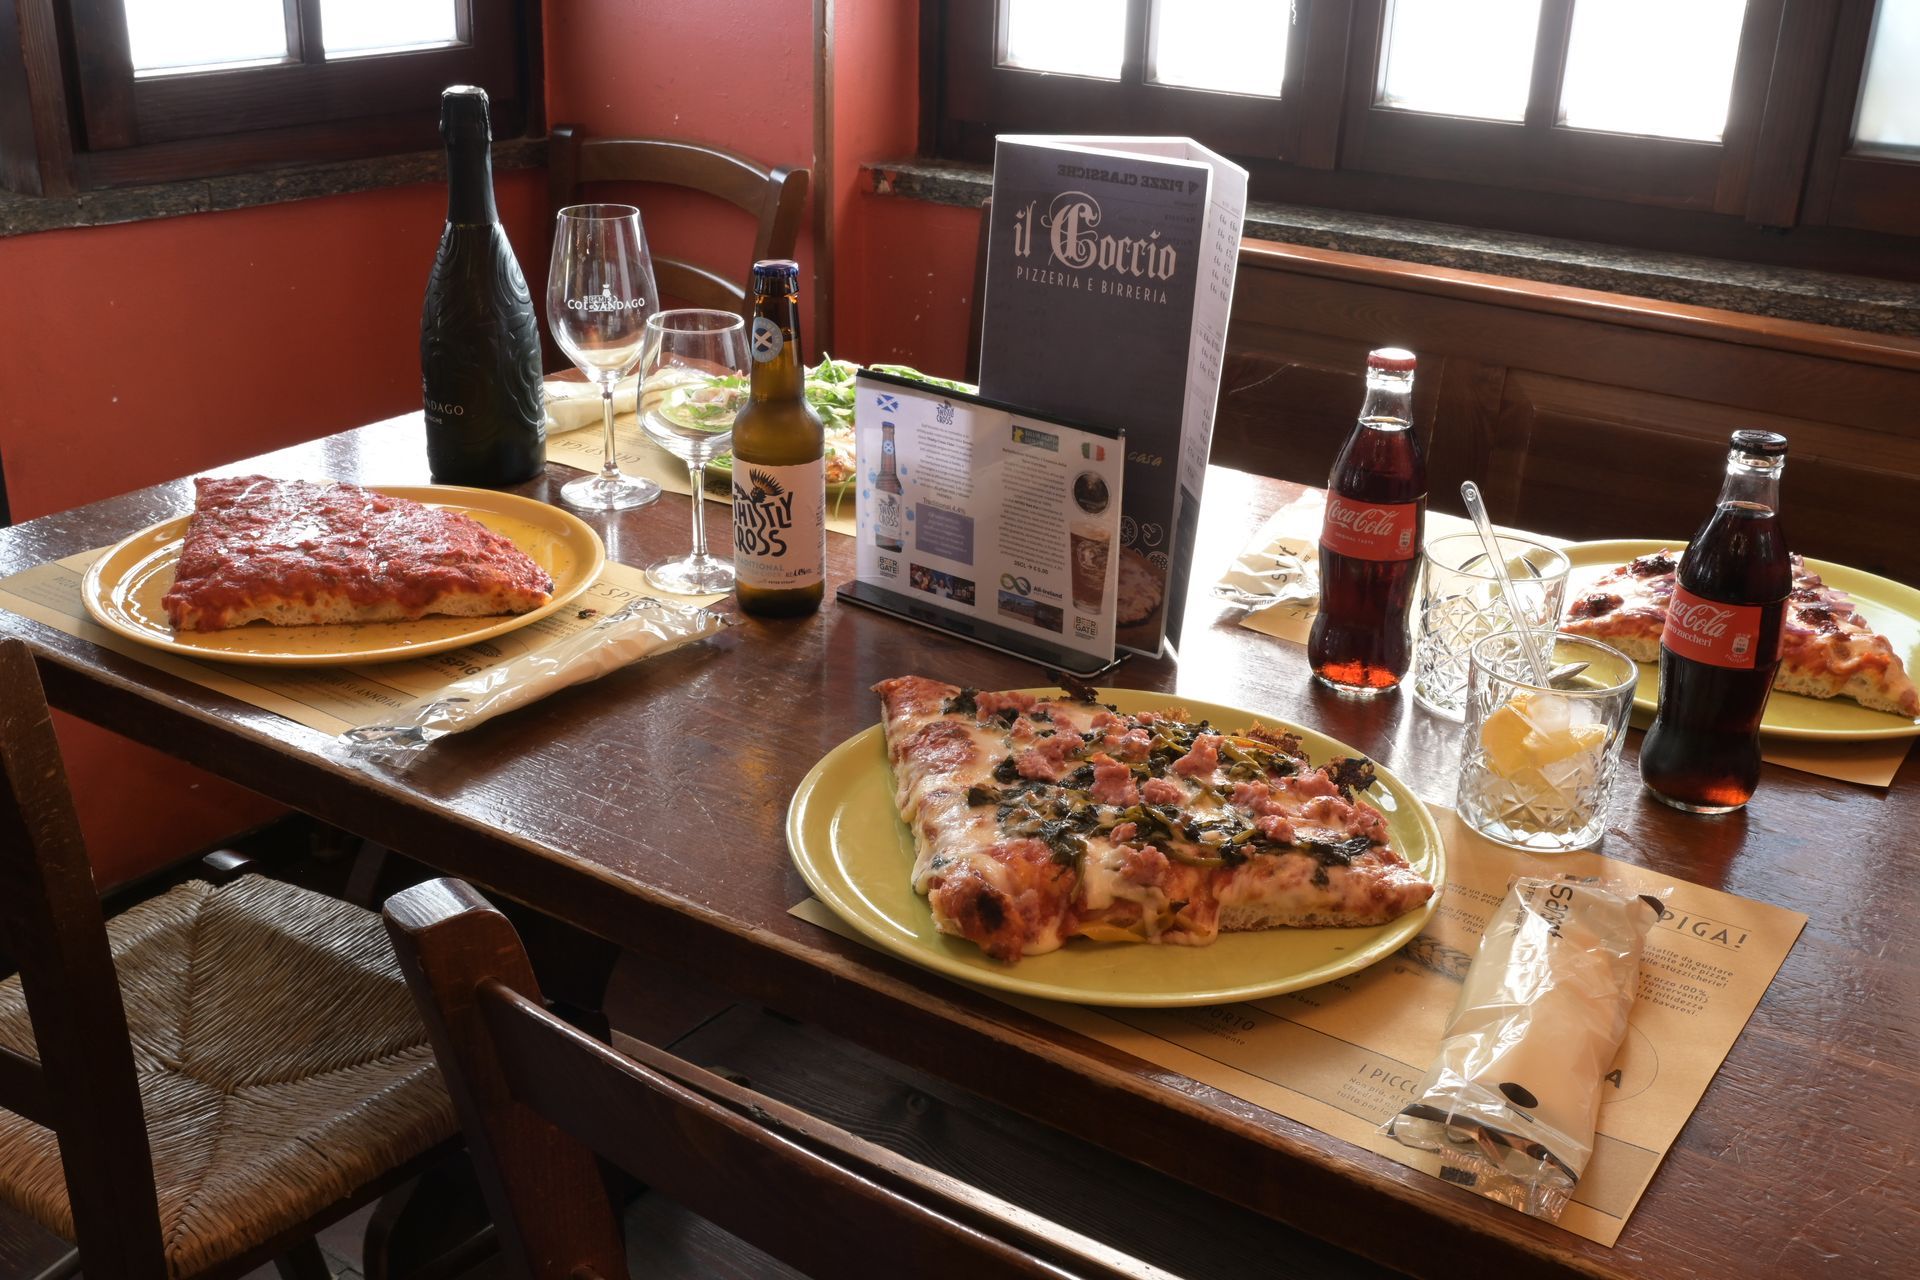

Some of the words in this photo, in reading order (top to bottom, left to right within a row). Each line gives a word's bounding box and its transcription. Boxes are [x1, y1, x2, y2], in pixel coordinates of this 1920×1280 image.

[1013, 200, 1037, 257] il
[1040, 190, 1177, 281] Coccio
[1016, 266, 1080, 289] PIZZERIA
[1087, 278, 1094, 291] E
[1101, 280, 1168, 304] BIRRERIA
[1127, 451, 1164, 467] casa
[733, 491, 793, 528] THISTLY
[1327, 500, 1400, 536] Coca-Cola
[879, 564, 898, 574] GATE
[600, 588, 640, 602] SPI
[1075, 624, 1097, 636] GATE
[1482, 892, 1504, 903] prod
[1656, 909, 1747, 949] PIGA!
